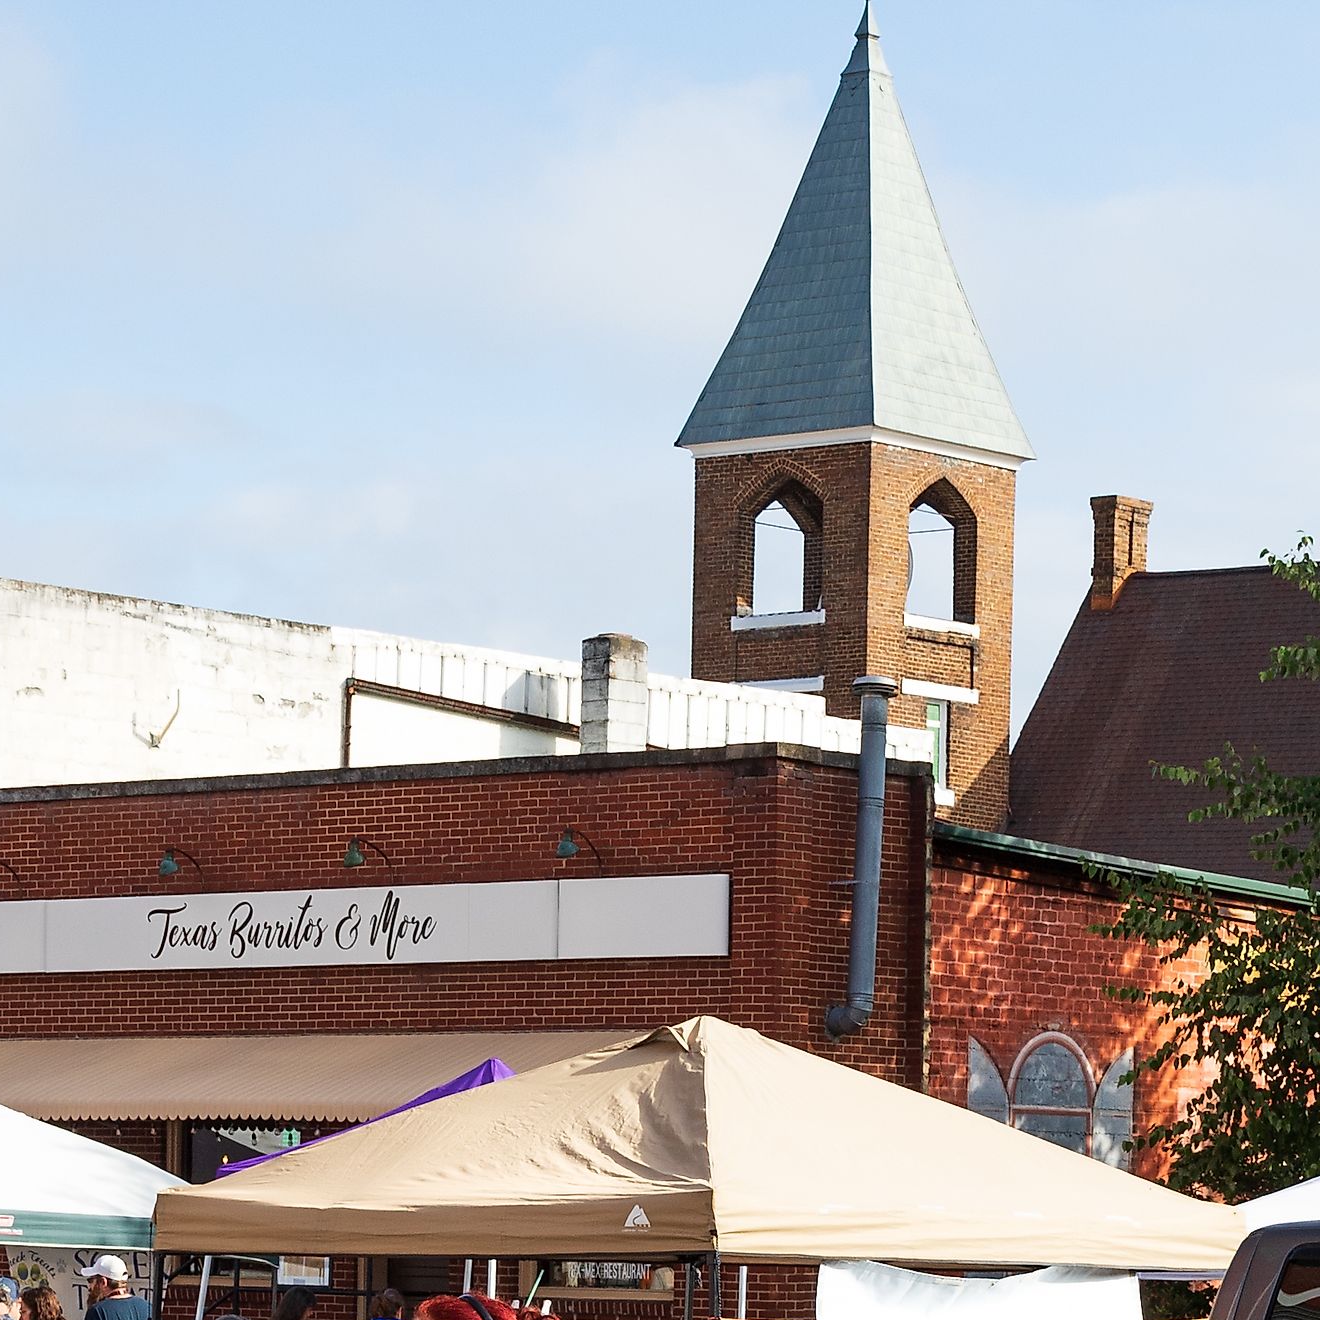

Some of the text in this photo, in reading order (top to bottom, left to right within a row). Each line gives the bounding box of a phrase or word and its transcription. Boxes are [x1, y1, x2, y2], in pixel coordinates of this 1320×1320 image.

[147, 890, 437, 960] Texas Burritos & More
[603, 1262, 652, 1280] RESTAURANT
